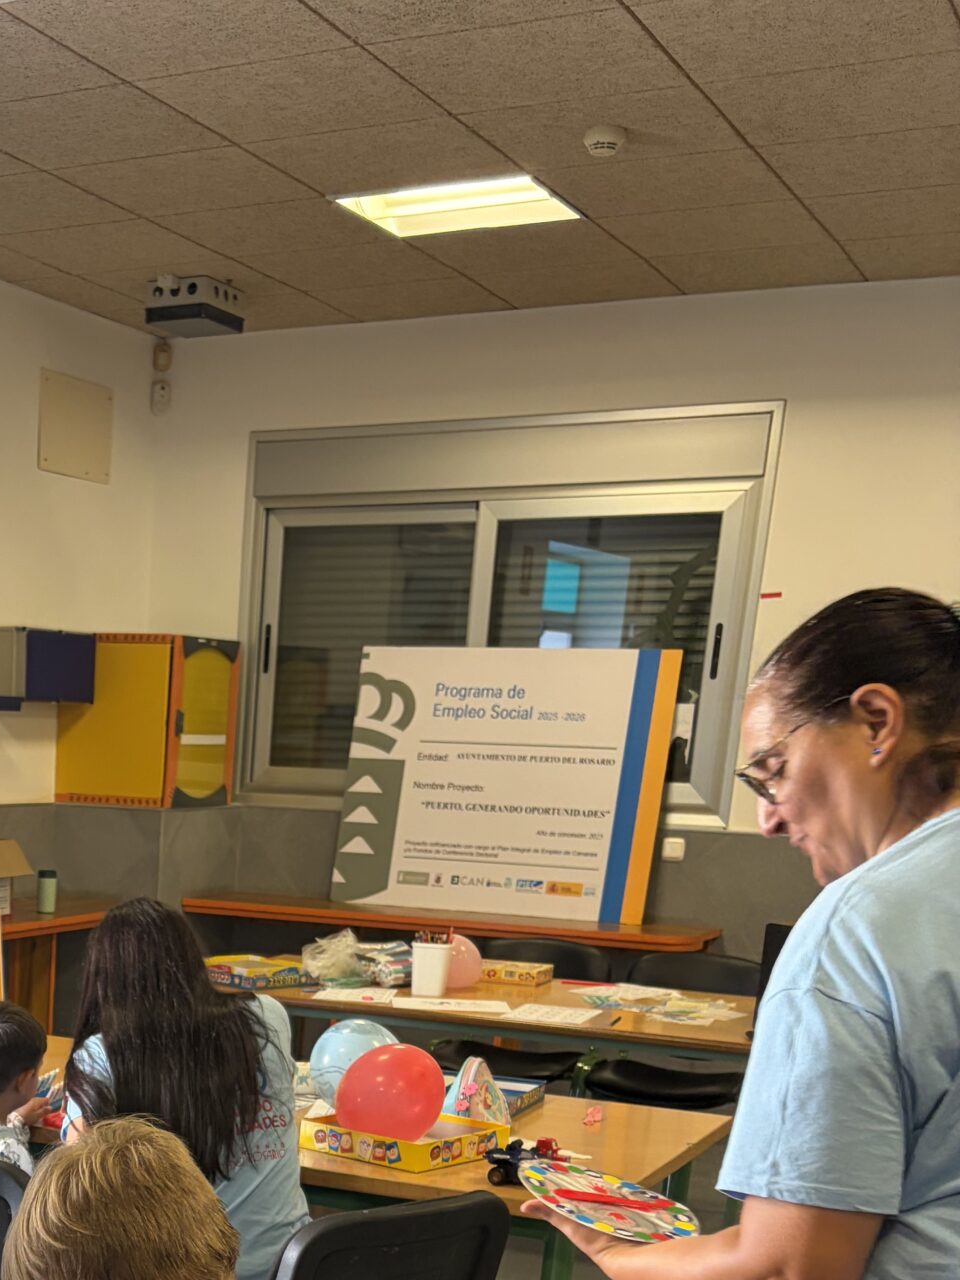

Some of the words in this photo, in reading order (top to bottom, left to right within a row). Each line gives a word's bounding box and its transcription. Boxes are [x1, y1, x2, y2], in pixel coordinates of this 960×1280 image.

[435, 682, 502, 701] Programa
[507, 684, 525, 699] de
[433, 703, 486, 721] Empleo
[491, 704, 534, 721] Social
[456, 753, 516, 763] AYUNTAMIENTO
[517, 755, 528, 763] DE
[529, 755, 561, 764] PUERTO
[562, 757, 577, 765] DEL
[579, 757, 616, 767] ROSARIO
[413, 781, 445, 791] Nombre
[447, 782, 485, 793] Proyecto:
[465, 803, 524, 815] GENERANDO
